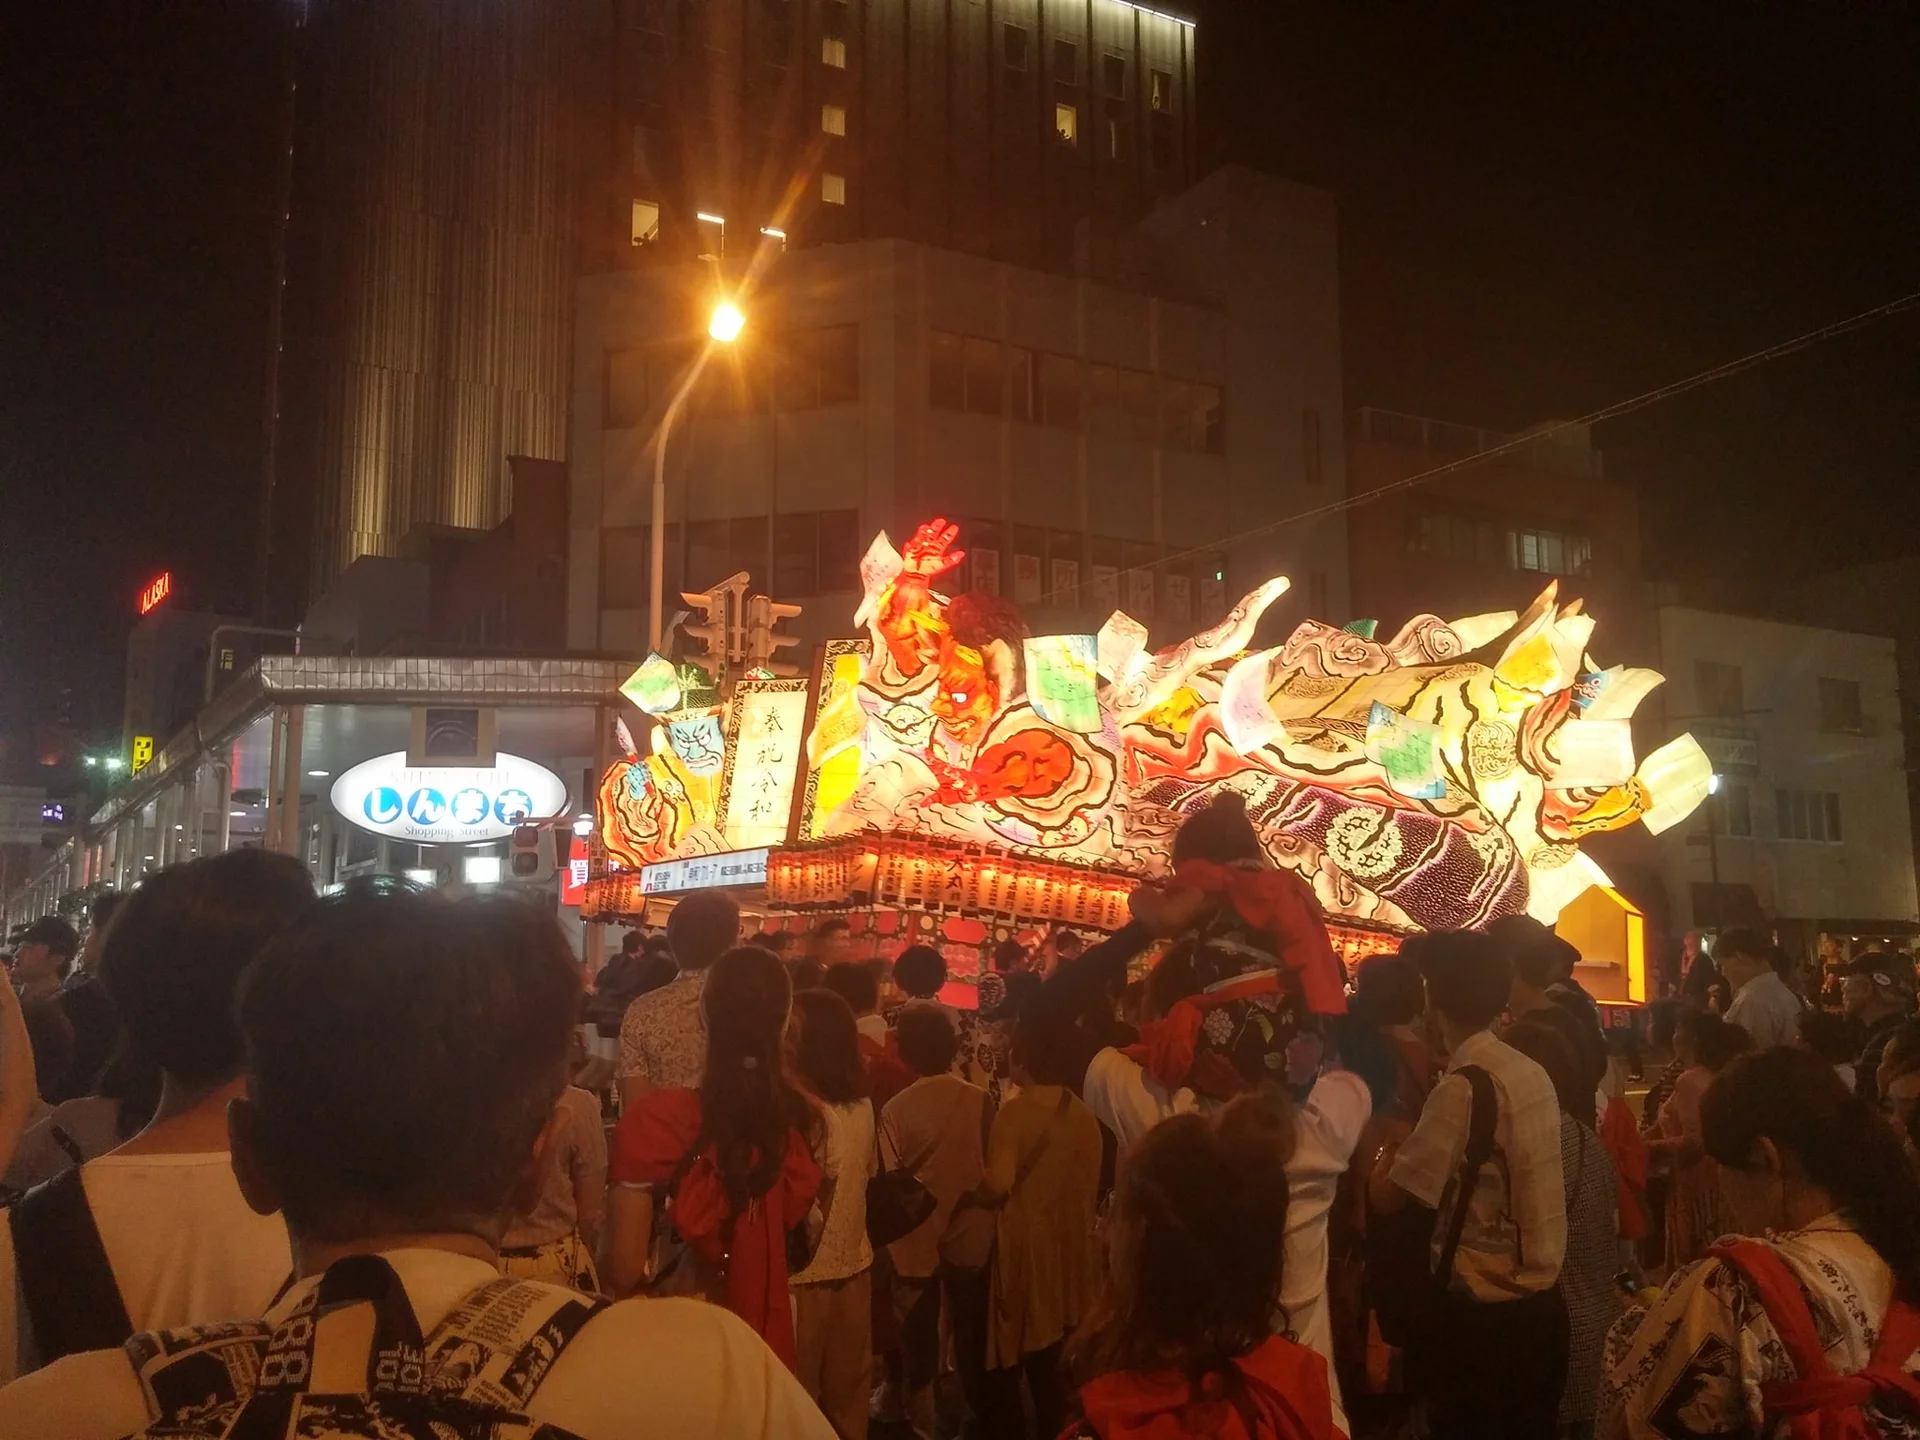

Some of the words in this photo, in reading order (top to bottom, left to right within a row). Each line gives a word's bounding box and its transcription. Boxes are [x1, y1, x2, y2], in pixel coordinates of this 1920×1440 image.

[141, 572, 169, 614] ALASKA
[366, 788, 532, 825] しんまち
[405, 826, 454, 839] Shopping
[459, 827, 489, 837] Street
